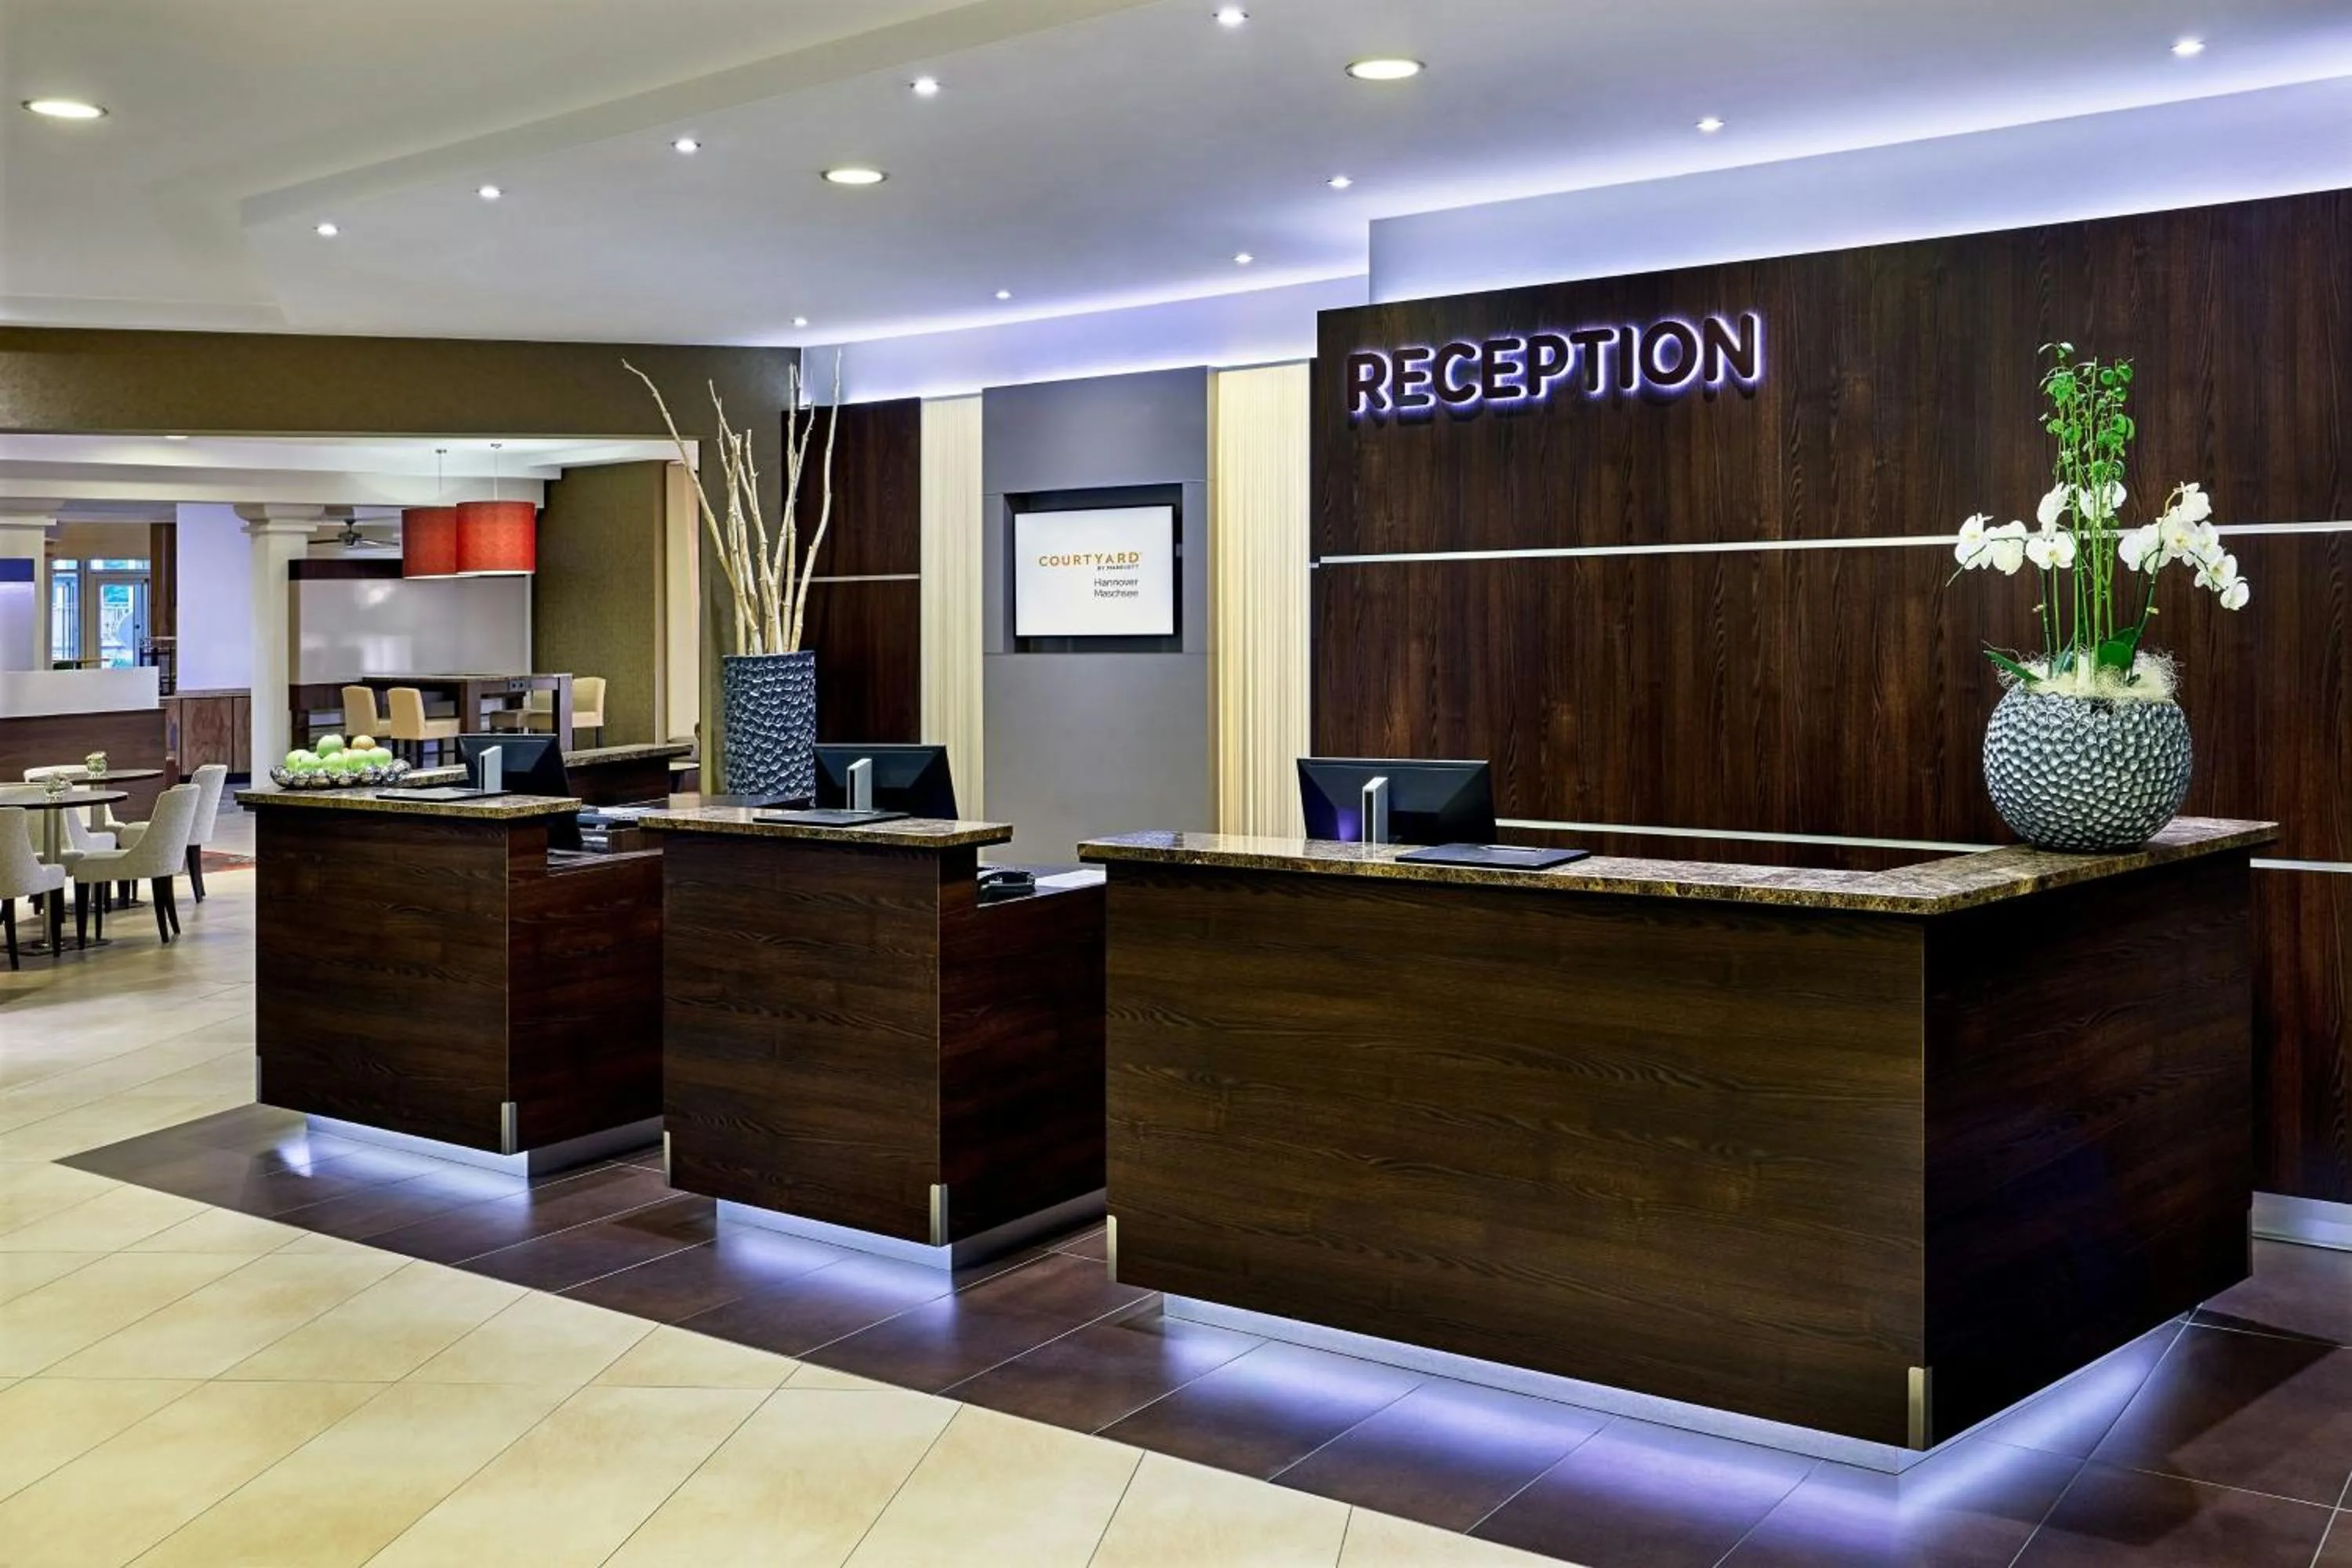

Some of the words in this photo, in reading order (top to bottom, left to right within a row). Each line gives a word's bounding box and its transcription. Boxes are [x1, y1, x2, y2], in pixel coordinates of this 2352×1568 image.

[1347, 314, 1758, 413] RECEPTION
[1039, 551, 1140, 567] COURTYARD
[1094, 578, 1139, 587] Hannover
